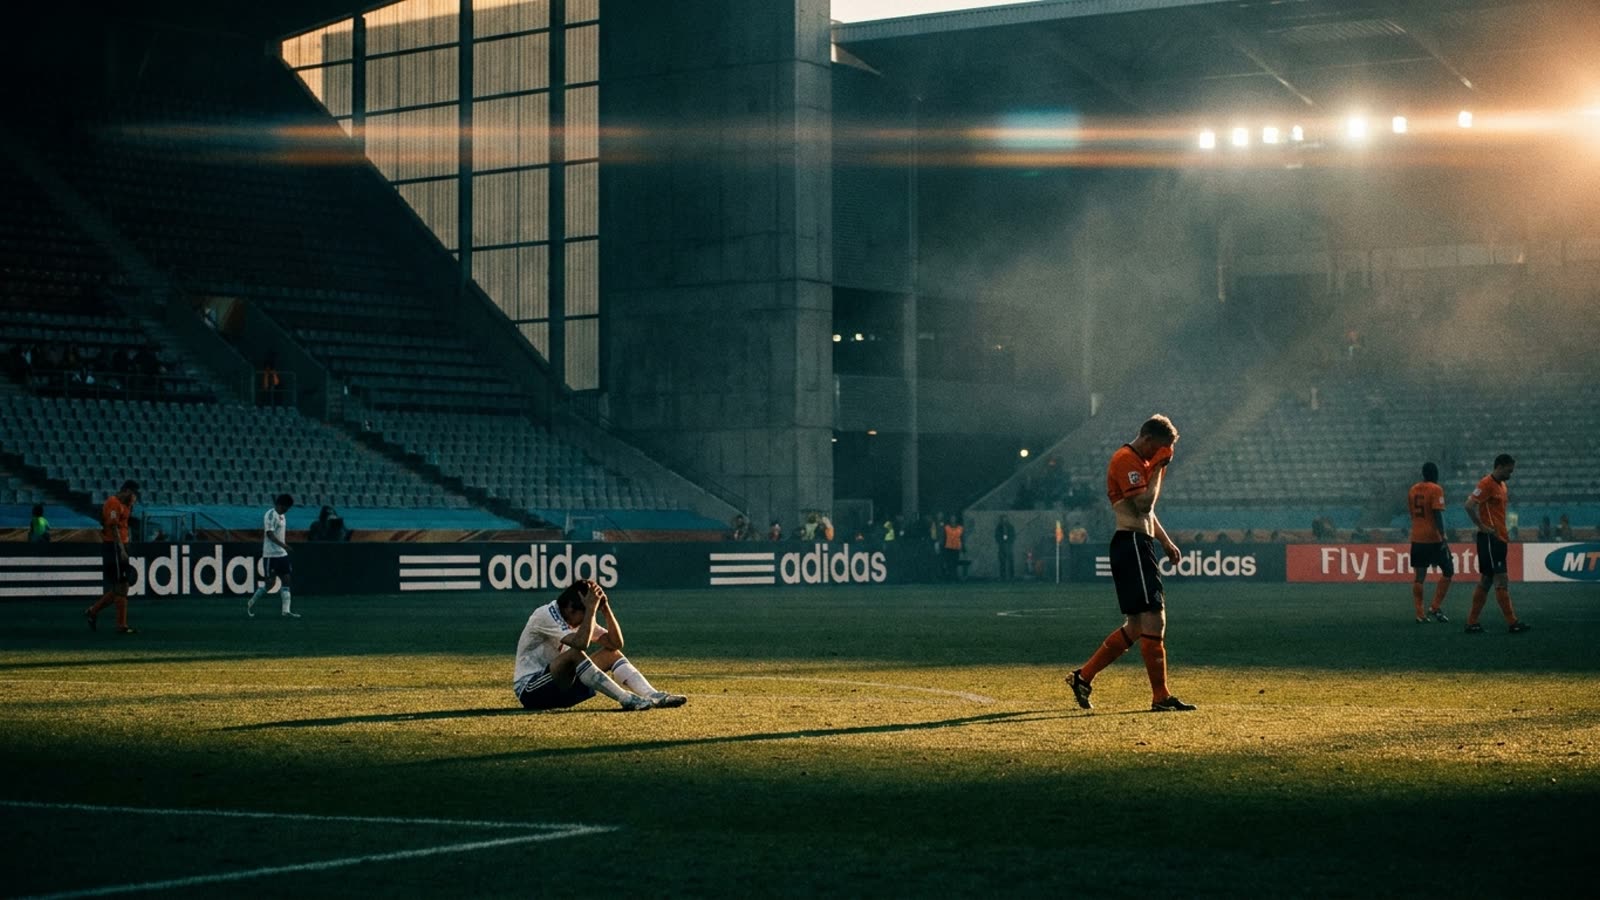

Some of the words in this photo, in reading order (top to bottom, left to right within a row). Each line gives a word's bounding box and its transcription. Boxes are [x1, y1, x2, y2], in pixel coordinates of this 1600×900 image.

[487, 543, 619, 590] adidas
[780, 543, 888, 584] adidas
[1158, 550, 1257, 576] adidas
[1320, 547, 1370, 581] Fly
[1562, 551, 1600, 572] MT
